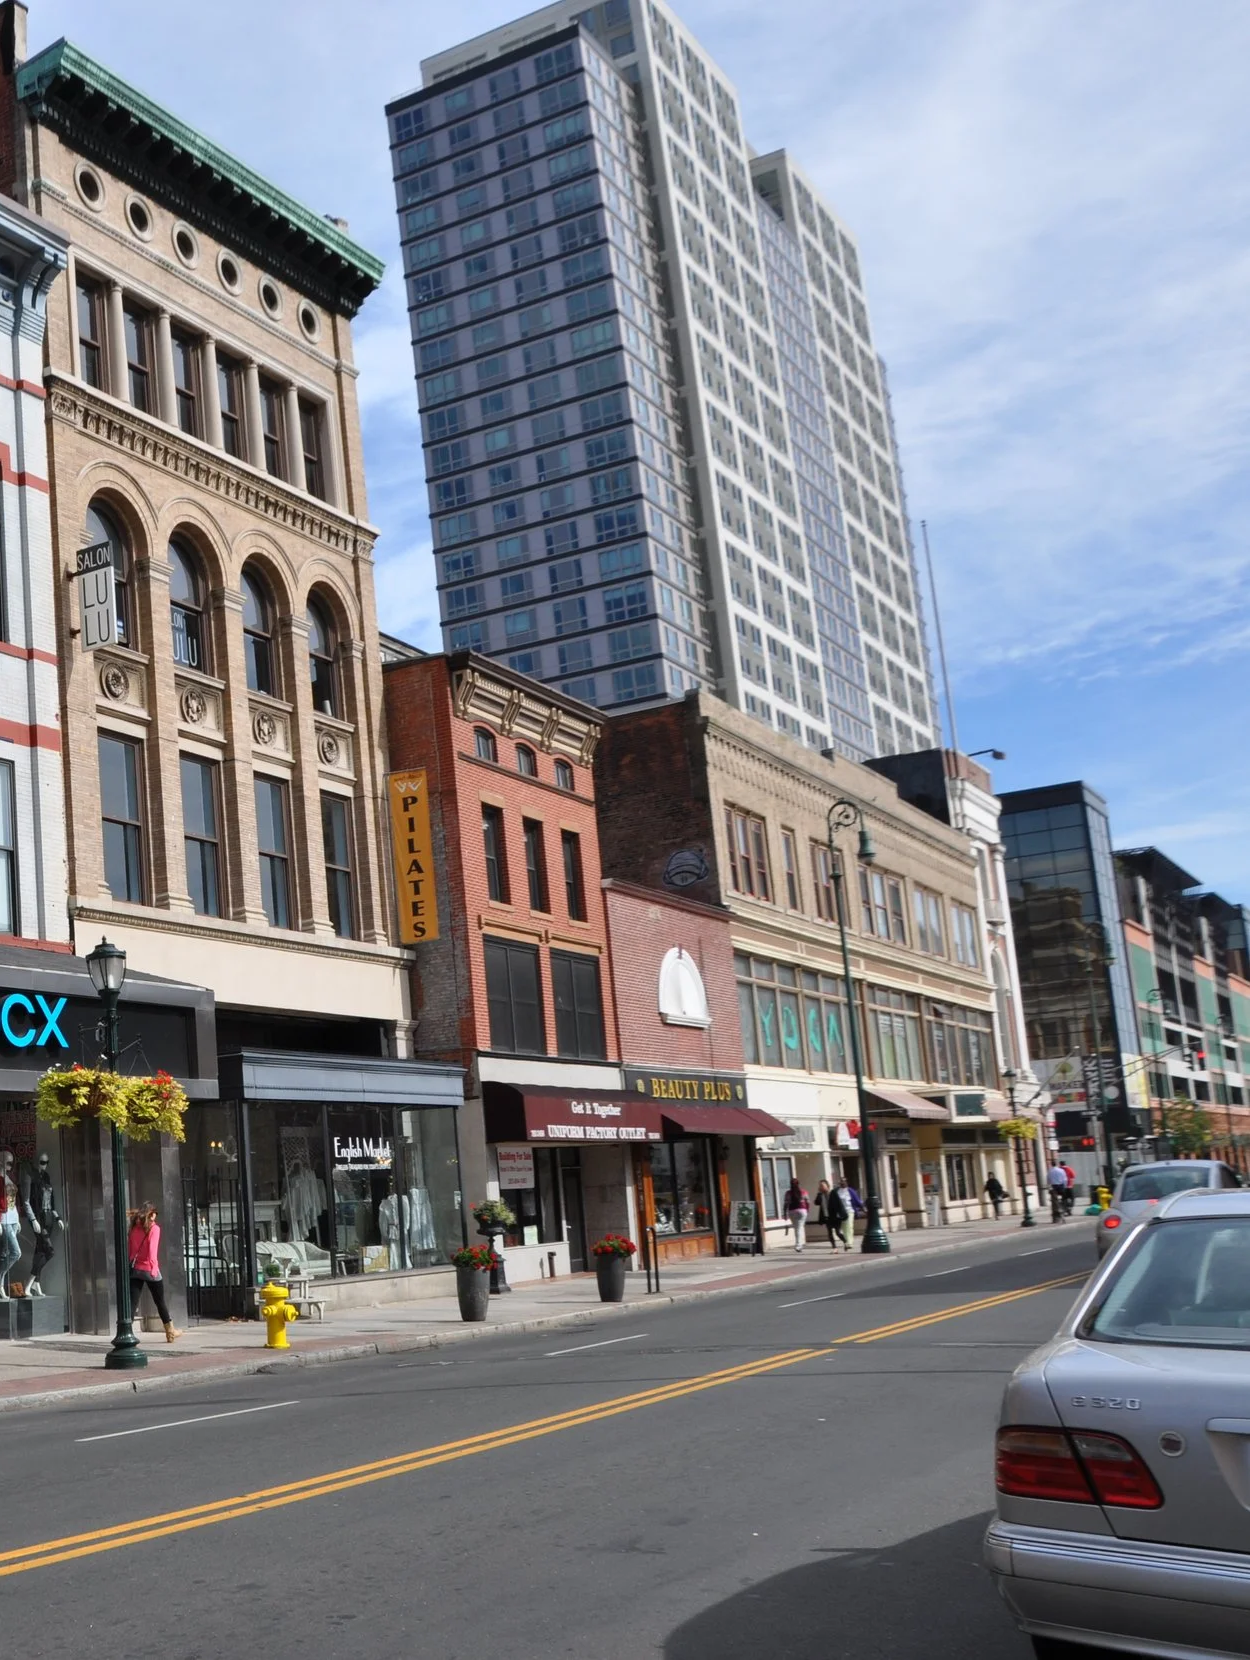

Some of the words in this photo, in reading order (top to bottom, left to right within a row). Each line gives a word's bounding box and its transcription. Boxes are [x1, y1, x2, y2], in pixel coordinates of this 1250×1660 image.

[77, 545, 110, 572] SALON
[82, 571, 108, 609] LU
[84, 608, 110, 647] LU
[401, 795, 427, 939] PILATES
[650, 1077, 699, 1100] BEAUTY
[702, 1081, 732, 1101] PLUS
[571, 1101, 585, 1114] Get
[592, 1102, 622, 1119] Together
[547, 1124, 584, 1138] UNIFORM
[585, 1126, 618, 1139] FACTORY
[618, 1127, 646, 1139] OUTLET
[333, 1136, 363, 1163] English
[362, 1136, 392, 1158] Market
